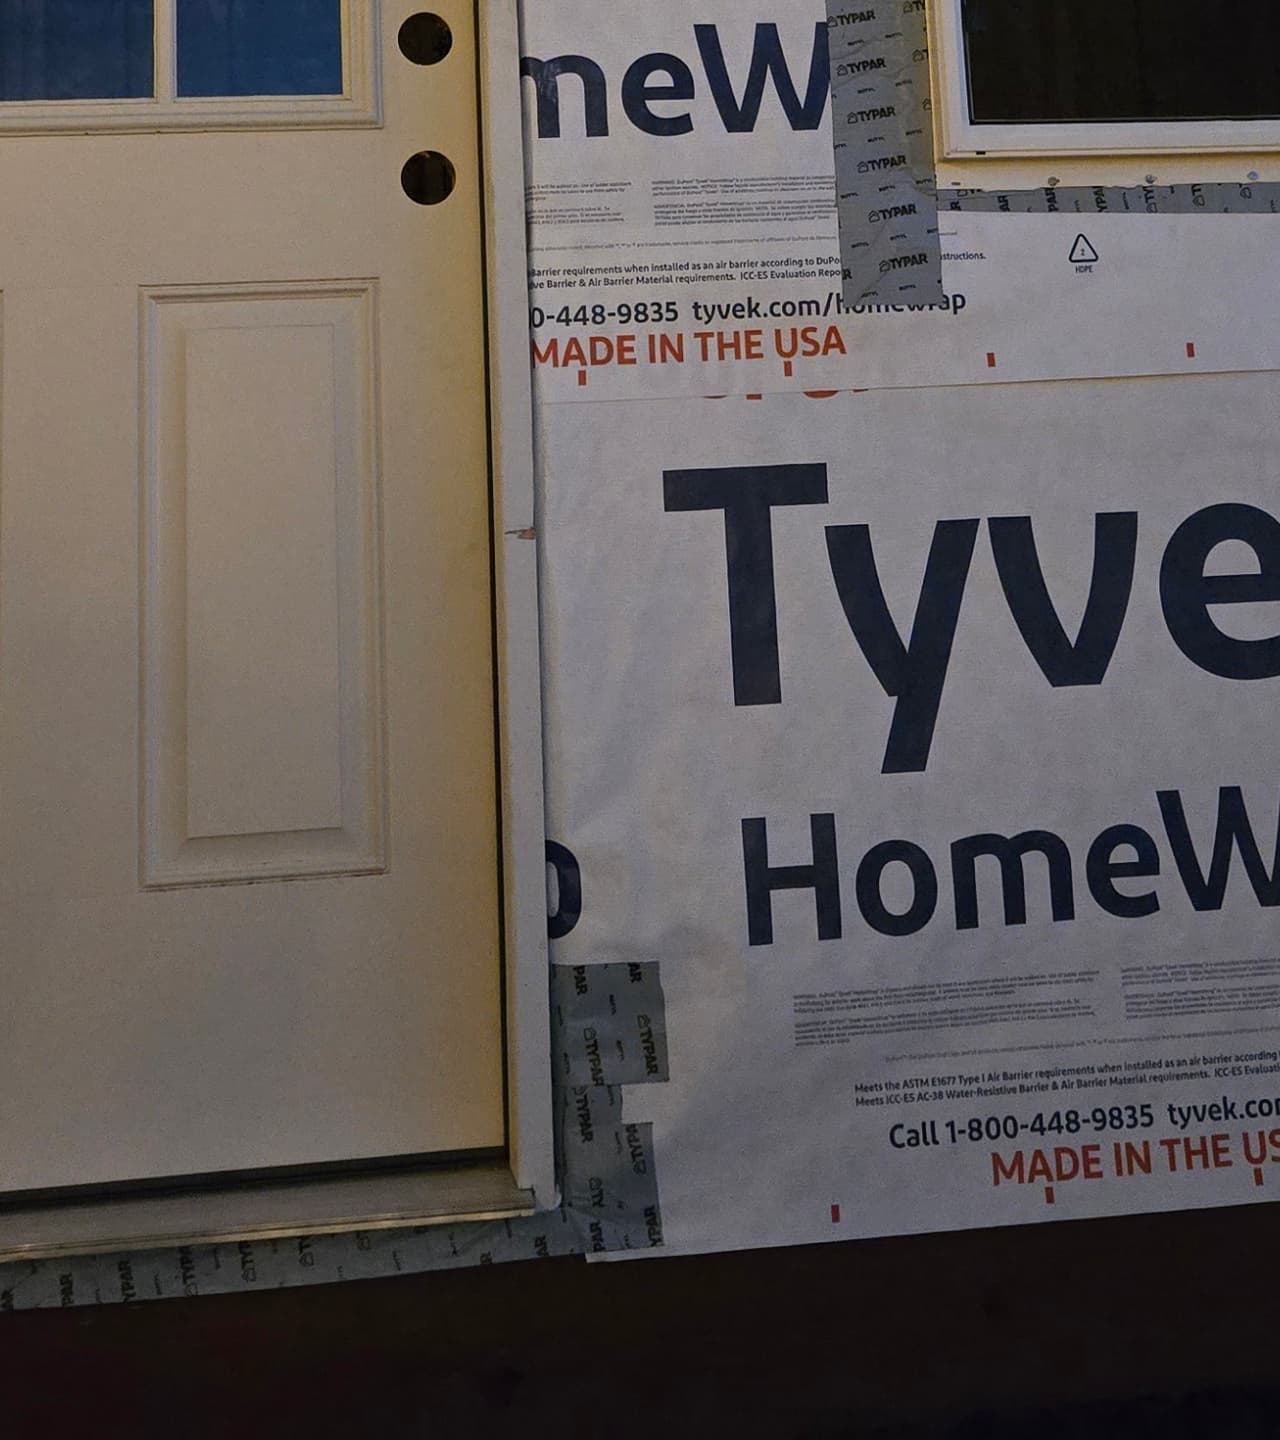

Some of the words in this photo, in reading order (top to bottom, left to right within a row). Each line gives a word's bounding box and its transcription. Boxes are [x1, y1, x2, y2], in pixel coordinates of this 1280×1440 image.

[837, 9, 876, 25] TYPAR
[847, 58, 886, 74] TYPAR
[857, 106, 896, 122] TYPAR
[868, 154, 906, 171] TYPAR
[879, 204, 916, 220] TYPAR
[562, 264, 622, 277] requirements
[624, 263, 650, 273] when
[651, 262, 690, 272] installed
[716, 261, 727, 269] air
[728, 259, 758, 269] barrier
[760, 258, 803, 270] according
[804, 257, 814, 266] to
[890, 252, 928, 269] TYPAR
[546, 278, 576, 288] Barrier
[588, 277, 602, 286] Air
[603, 276, 634, 286] Barrier
[636, 275, 673, 284] Material
[740, 271, 768, 280] ICC-ES
[770, 269, 816, 279] Evaluation
[532, 335, 637, 368] MADE
[648, 333, 684, 364] IN
[694, 329, 764, 362] THE
[774, 325, 846, 358] USA
[854, 1081, 883, 1092] Meets
[884, 1080, 900, 1090] the
[902, 1077, 929, 1089] ASTM
[931, 1075, 956, 1086] E1677
[958, 1074, 980, 1086] Type
[987, 1072, 1001, 1082] Air
[1002, 1070, 1032, 1081] Barrier
[1035, 1065, 1095, 1080] requirements
[1097, 1063, 1122, 1073] when
[1124, 1060, 1162, 1071] installed
[1190, 1057, 1201, 1066] air
[1202, 1055, 1232, 1065] barrier
[1234, 1051, 1277, 1064] according
[856, 1095, 884, 1106] Meets
[886, 1092, 915, 1104] ICC-ES
[916, 1090, 944, 1101] AC-38
[1019, 1082, 1049, 1093] Barrier
[1061, 1080, 1074, 1090] Air
[1076, 1077, 1108, 1088] Barrier
[1110, 1074, 1147, 1086] Material
[1214, 1066, 1243, 1078] ICC-ES
[889, 1120, 939, 1149] Call
[945, 1104, 1154, 1144] 1-800-448-9835
[990, 1144, 1103, 1186] MADE
[1114, 1140, 1152, 1176] IN
[1160, 1134, 1232, 1172] THE
